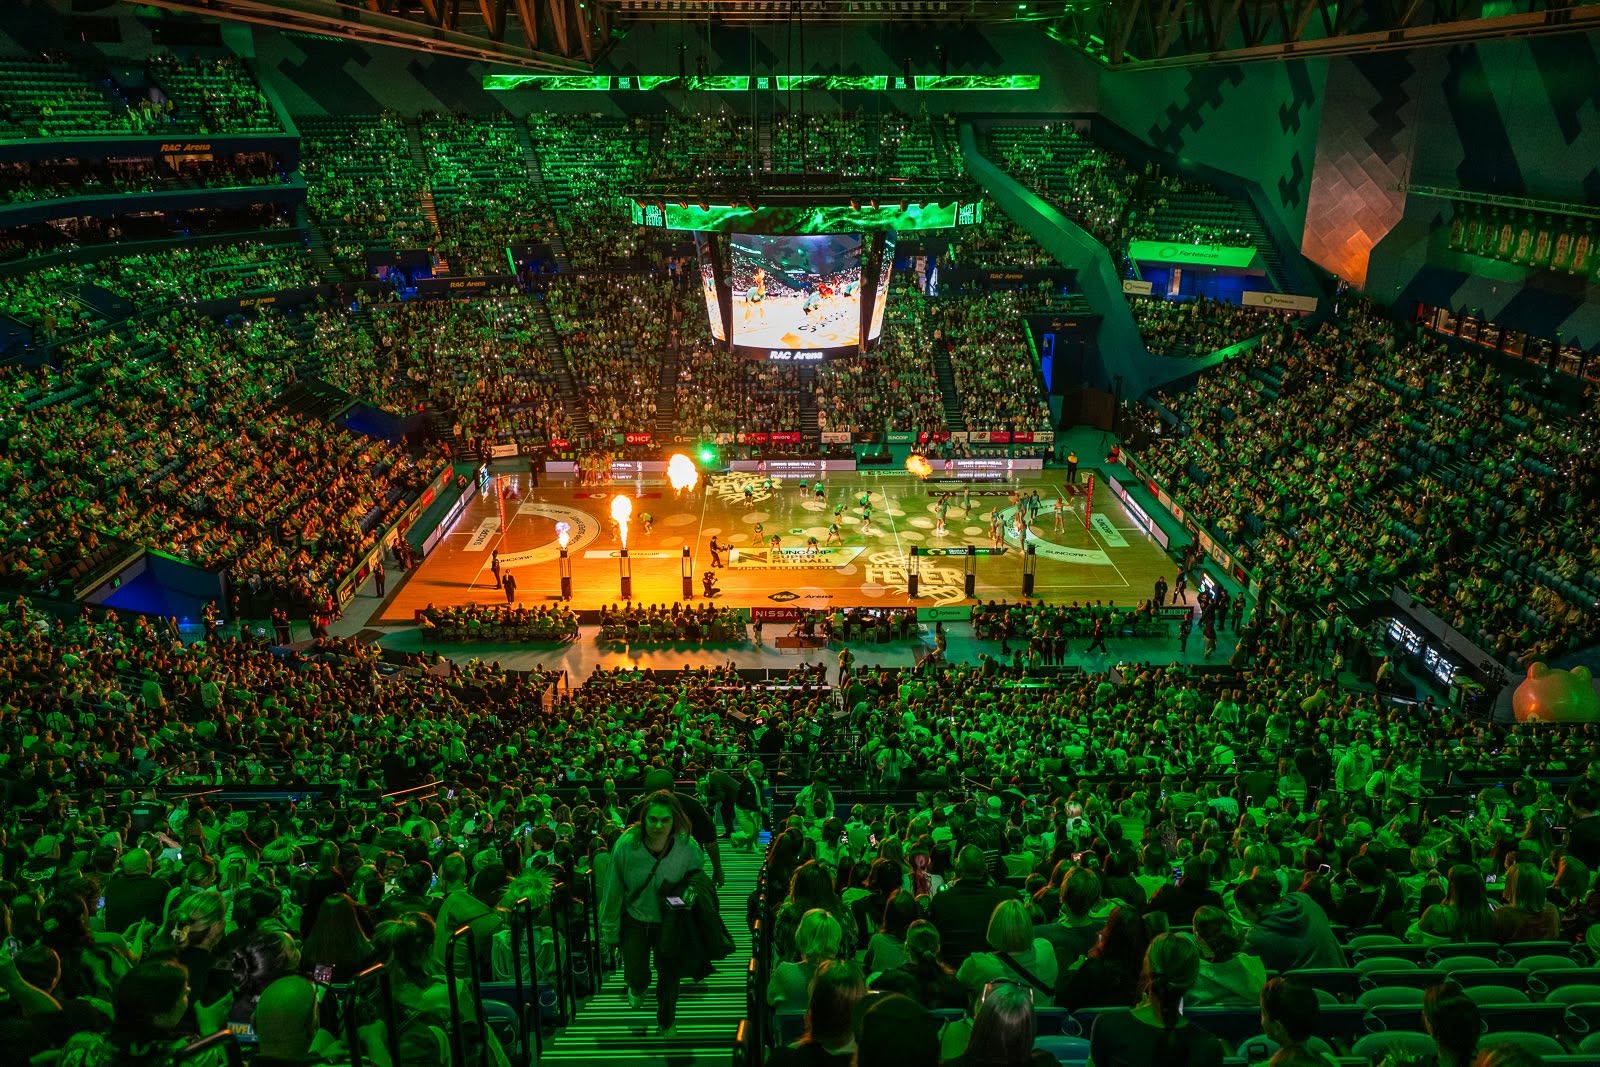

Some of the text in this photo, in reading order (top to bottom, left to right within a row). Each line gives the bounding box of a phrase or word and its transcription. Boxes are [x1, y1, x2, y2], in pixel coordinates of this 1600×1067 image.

[160, 144, 182, 152] RAC
[1178, 250, 1219, 259] Fortescue
[240, 299, 255, 307] RAC
[770, 351, 823, 360] RAC Arena
[1095, 518, 1114, 536] SUNCORP
[473, 528, 491, 546] SUNCORP
[1045, 549, 1088, 557] SUNCORP
[865, 567, 967, 584] FEVER
